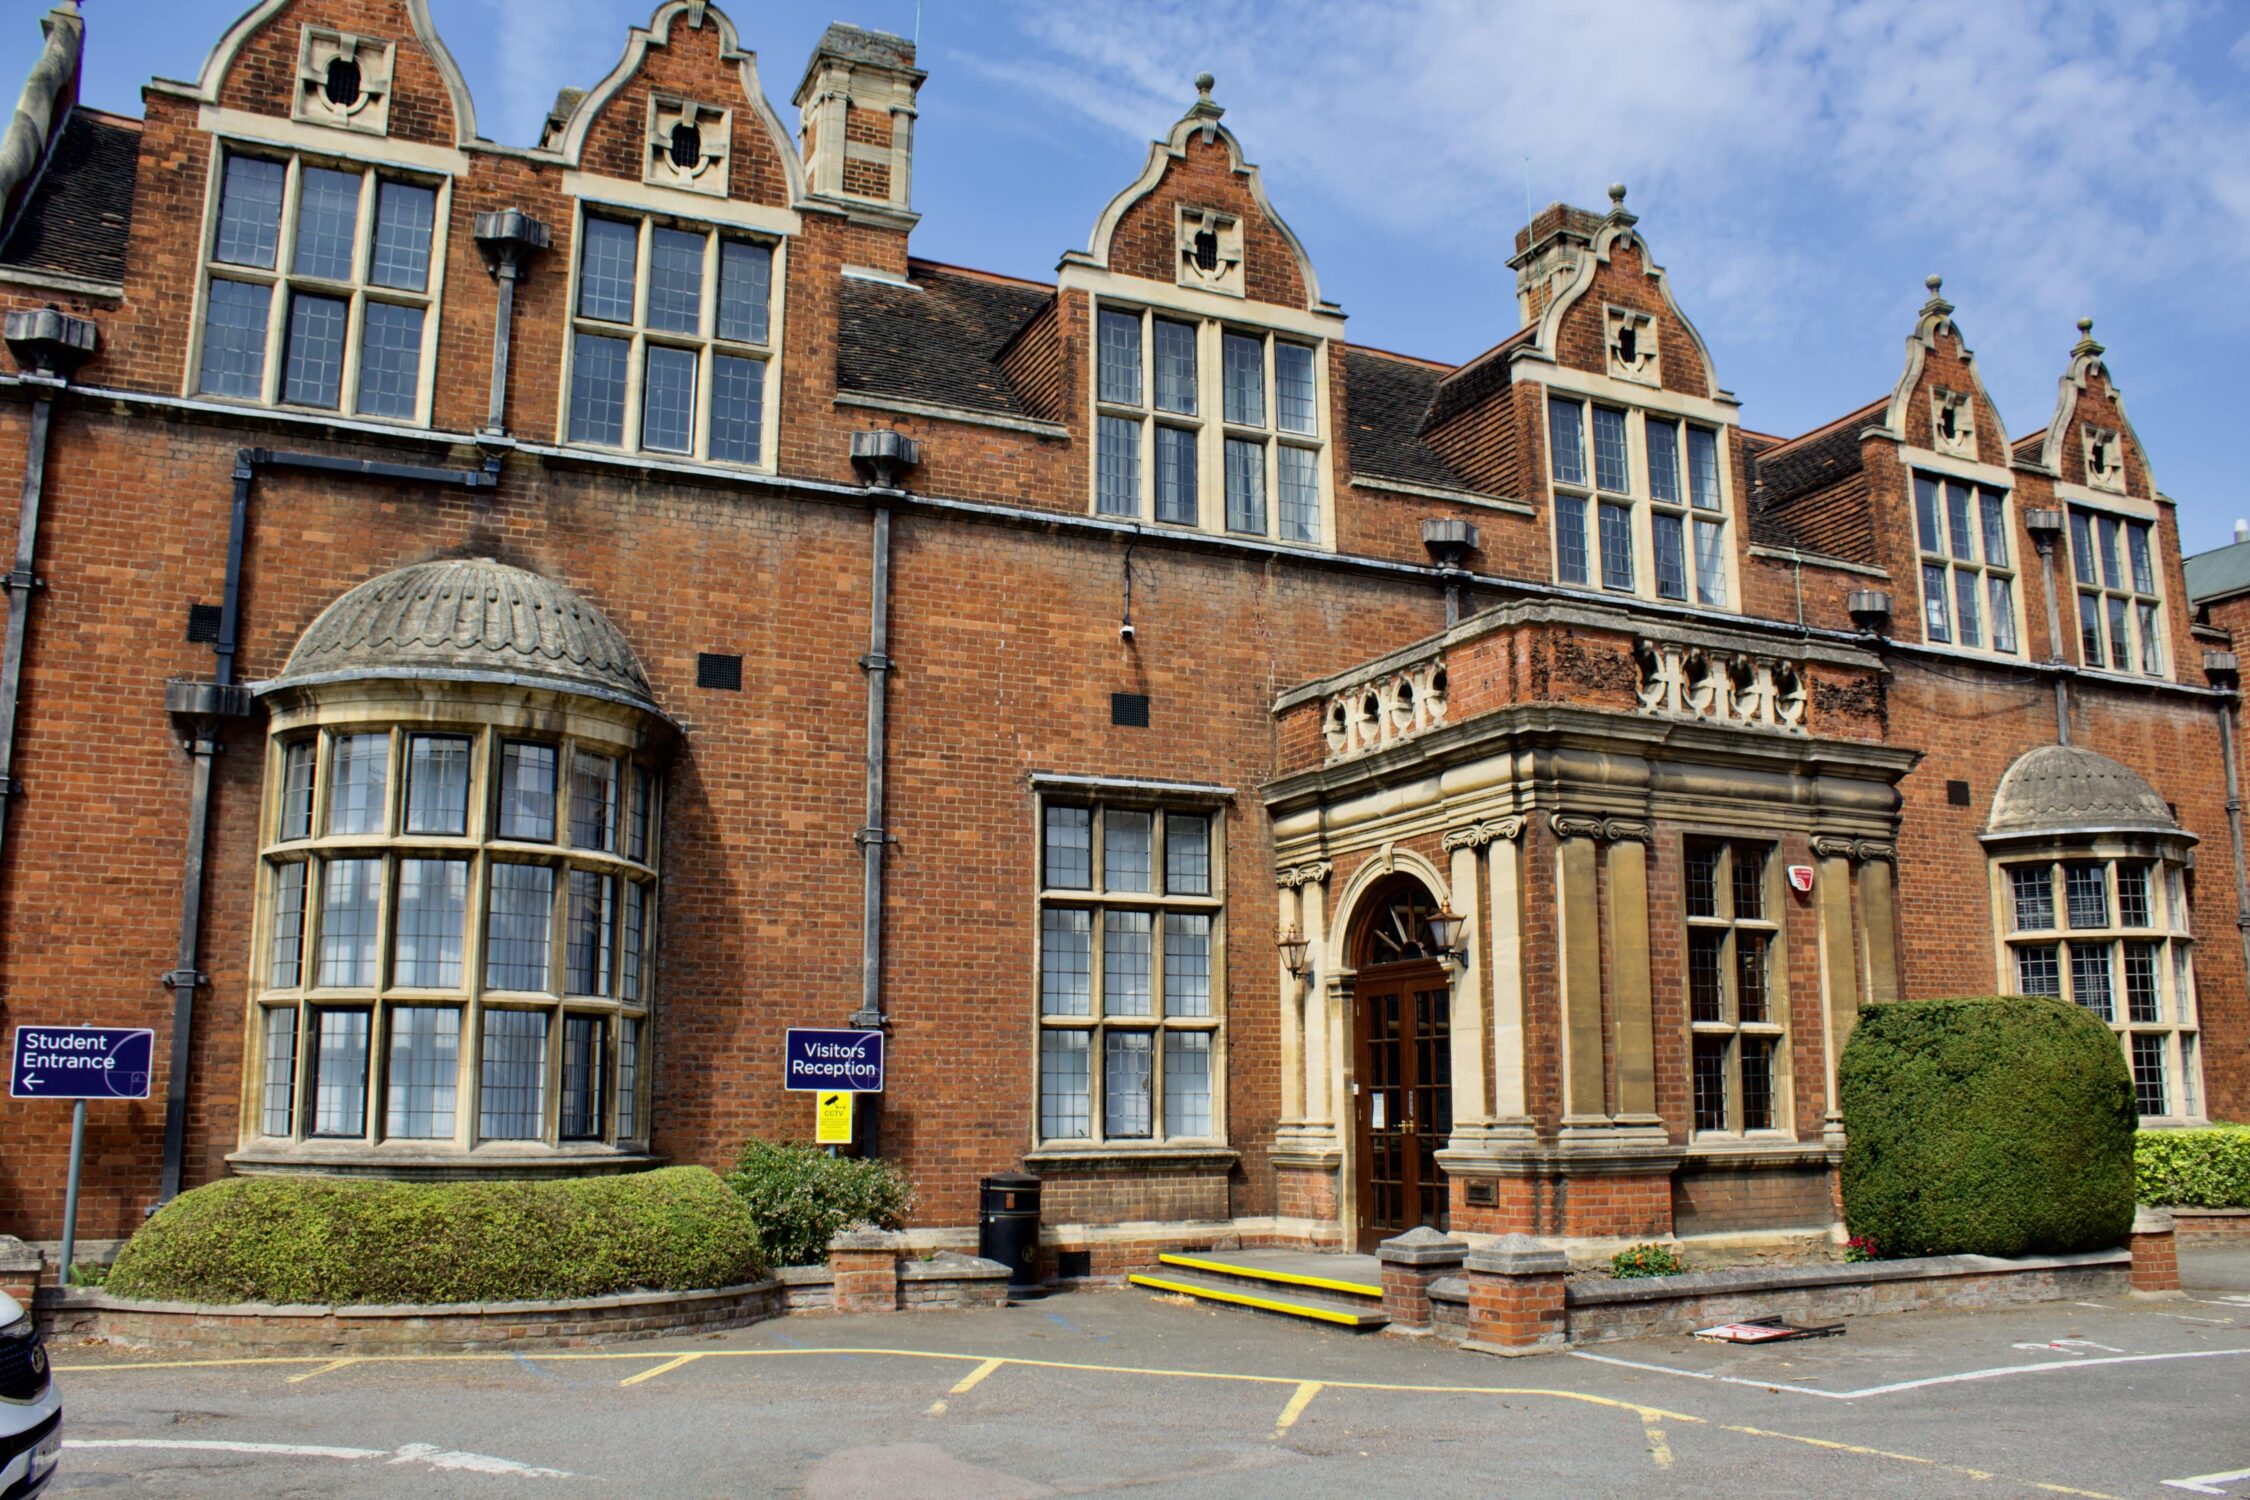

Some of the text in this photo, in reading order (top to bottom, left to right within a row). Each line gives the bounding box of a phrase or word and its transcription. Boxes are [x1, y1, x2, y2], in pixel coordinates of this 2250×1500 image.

[25, 1033, 107, 1050] Student
[804, 1043, 865, 1058] Visitors
[23, 1052, 115, 1069] Entrance
[792, 1059, 875, 1078] Reception
